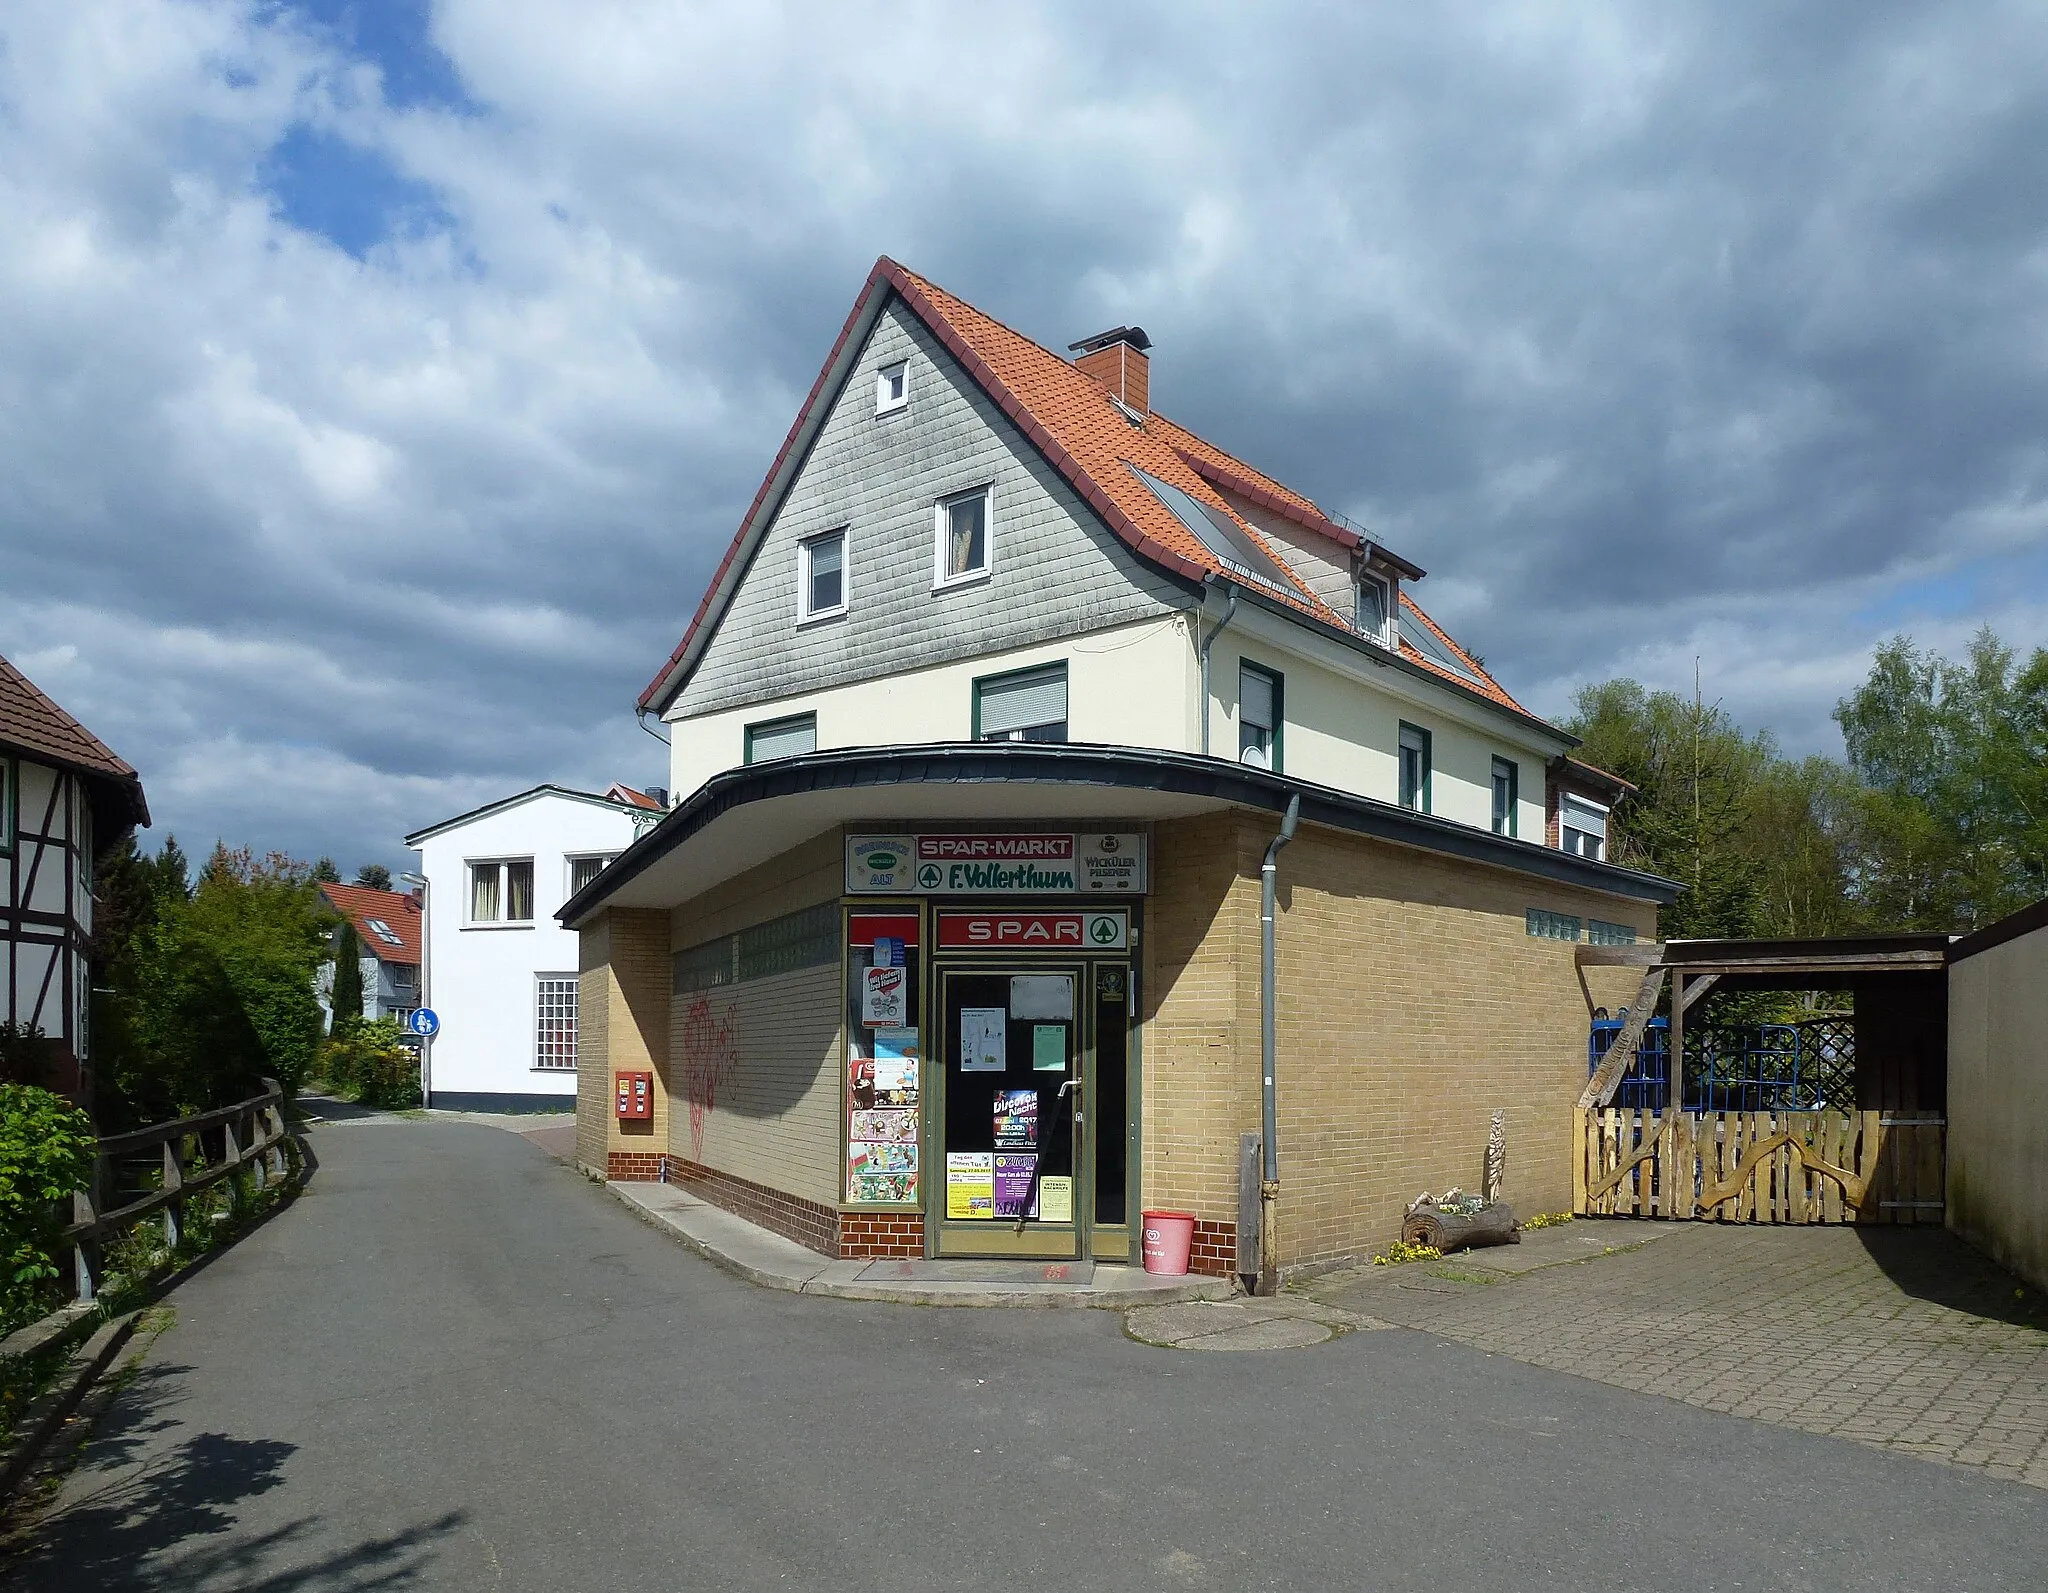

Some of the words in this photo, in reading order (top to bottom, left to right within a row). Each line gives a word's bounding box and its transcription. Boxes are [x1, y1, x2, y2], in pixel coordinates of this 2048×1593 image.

[921, 840, 1069, 855] SPAR-MARKT
[1084, 856, 1136, 868] WICKÜLER
[870, 873, 894, 885] ALT
[968, 921, 1079, 940] SPAR
[1009, 1101, 1038, 1117] Nacht
